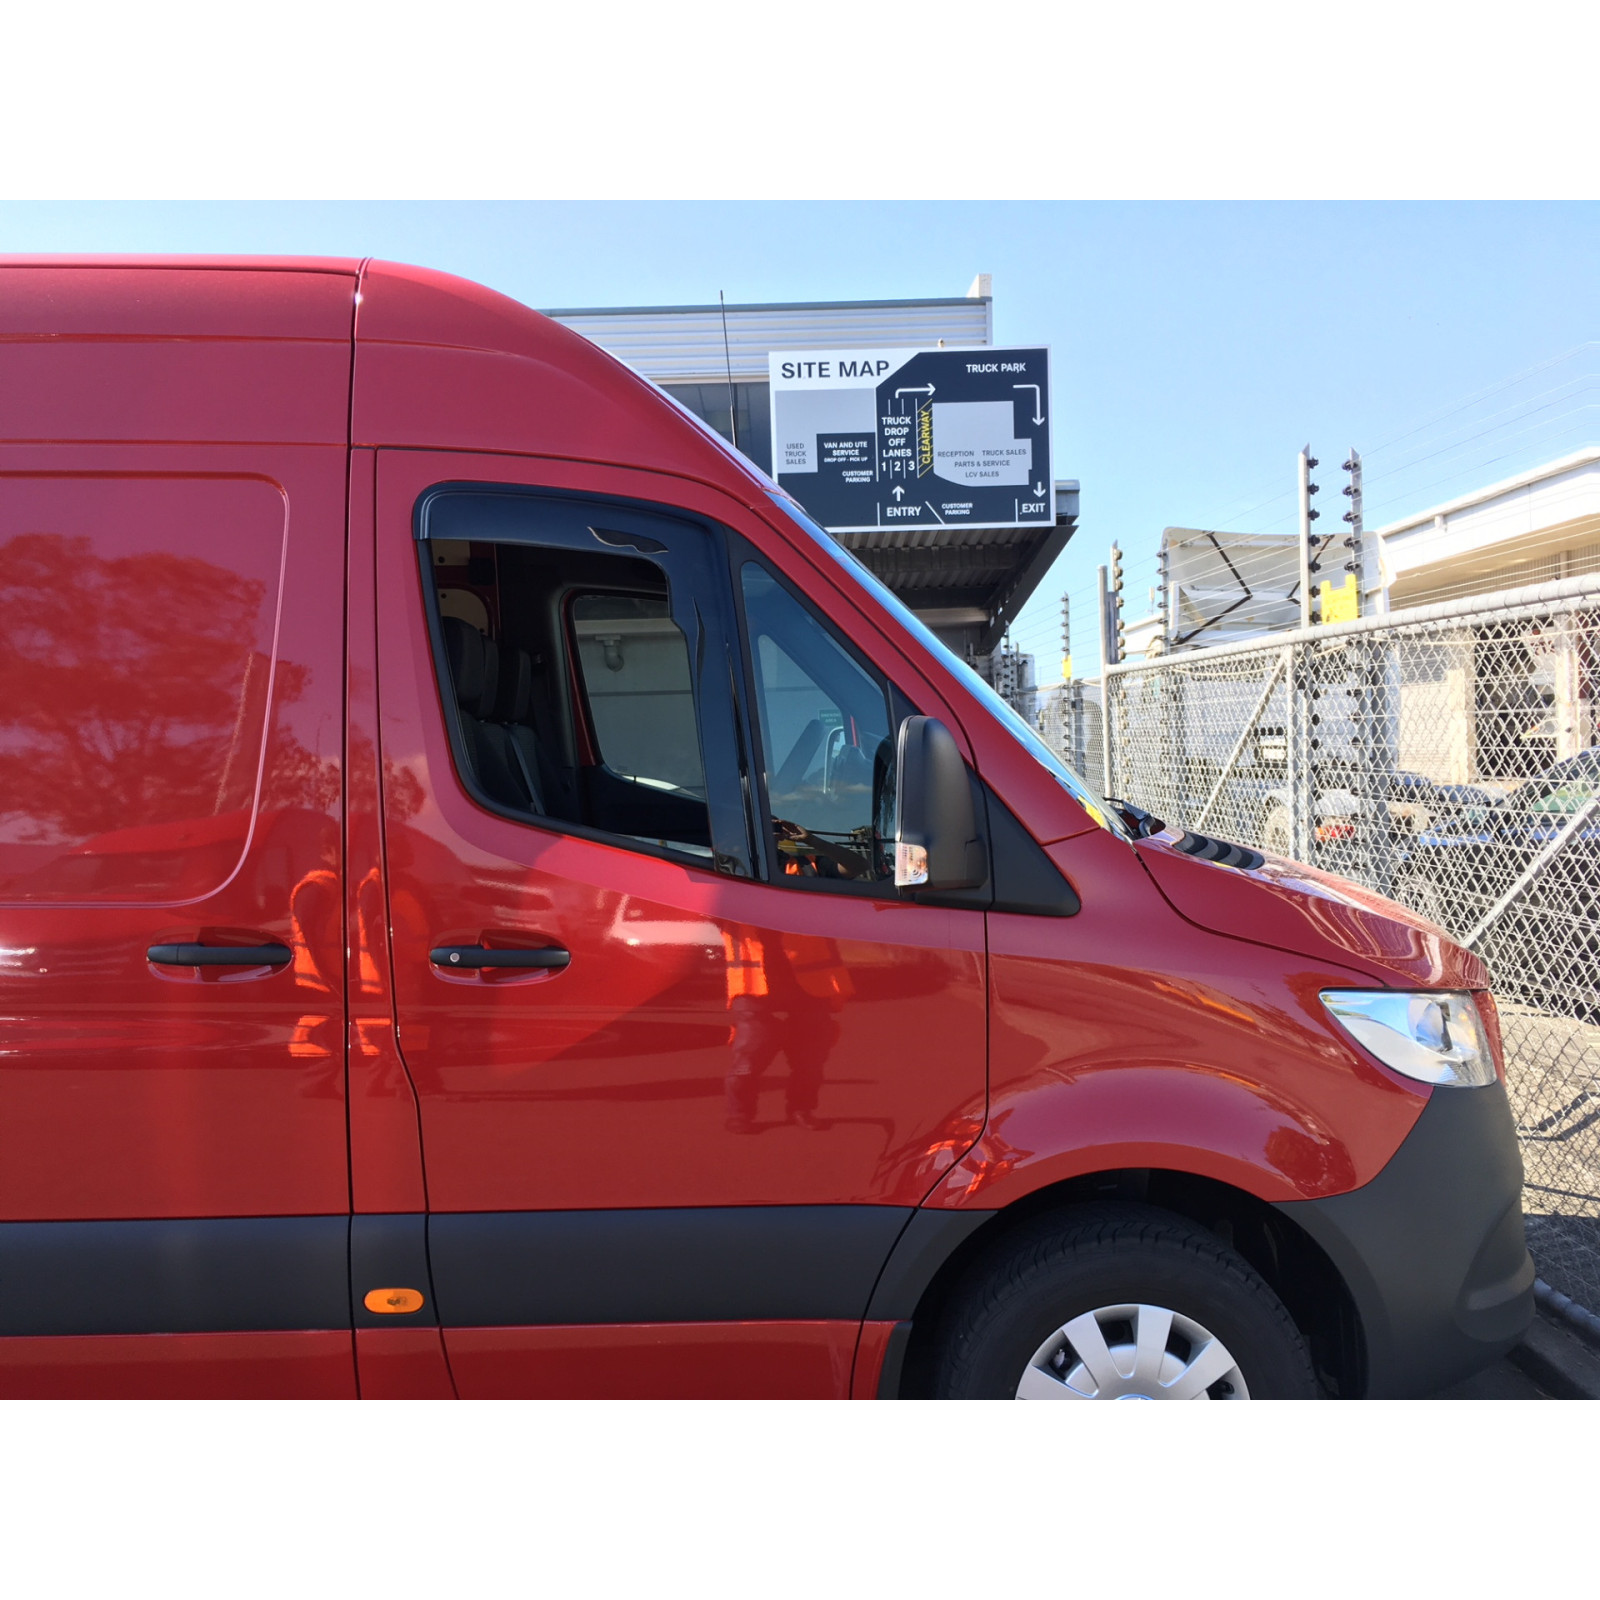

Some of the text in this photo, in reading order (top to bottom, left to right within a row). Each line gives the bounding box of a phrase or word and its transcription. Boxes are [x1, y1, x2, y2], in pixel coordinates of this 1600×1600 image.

[781, 360, 889, 379] SITE MAP
[966, 362, 1026, 373] TRUCK PARK
[881, 416, 911, 425] TRUCK
[884, 427, 909, 436] DROP
[921, 410, 931, 464] CLEARWAY
[888, 438, 906, 447] OFF
[832, 449, 859, 457] SERVICE
[882, 448, 912, 458] LANES
[937, 450, 975, 458] RECEPTION
[982, 448, 1027, 457] TRUCK SALES
[881, 460, 915, 472] 1 2 3
[954, 460, 975, 468] PARTS
[982, 459, 1010, 467] SERVICE
[979, 470, 1000, 478] SALES
[886, 506, 921, 517] ENTRY
[1022, 502, 1045, 512] EXIT
